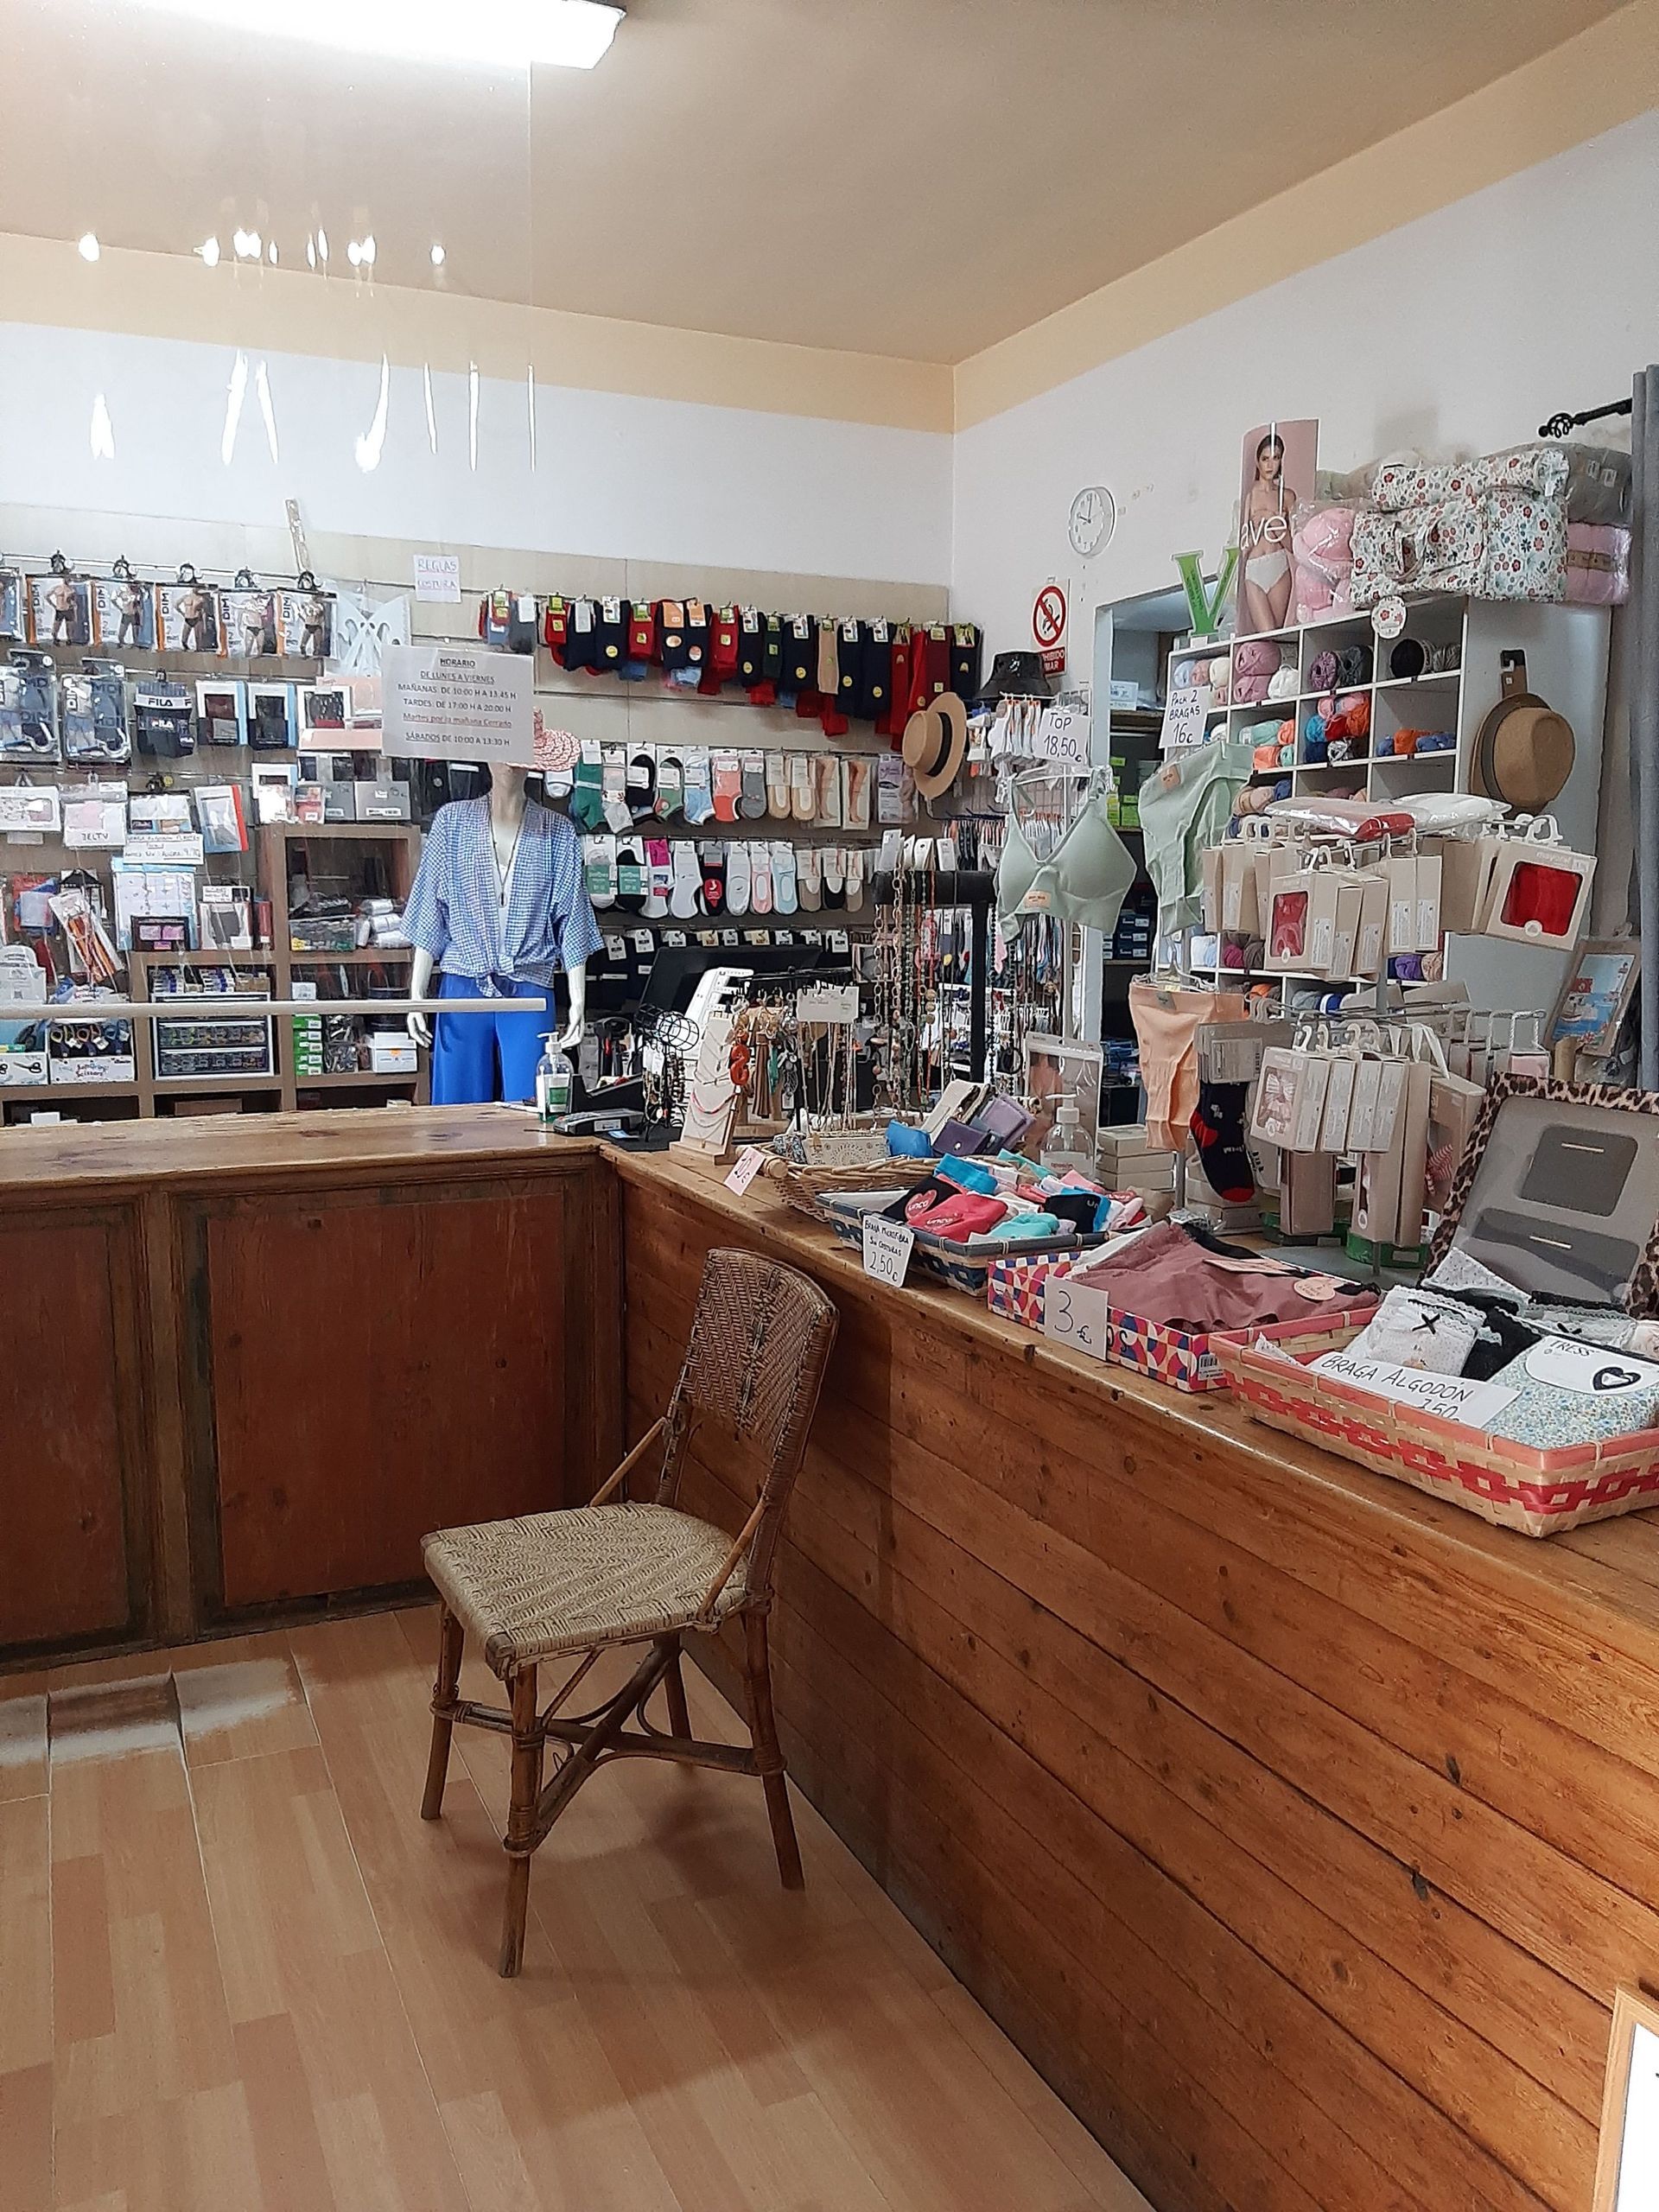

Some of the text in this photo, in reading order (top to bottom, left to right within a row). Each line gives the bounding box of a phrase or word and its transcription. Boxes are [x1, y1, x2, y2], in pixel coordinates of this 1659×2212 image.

[221, 597, 230, 620] DIM
[283, 596, 292, 619] DIM
[1042, 649, 1065, 662] HIBIDO
[440, 658, 475, 668] HORARIO
[1045, 661, 1058, 671] MAR
[420, 671, 430, 679] DE
[432, 672, 456, 681] LUNES
[463, 674, 495, 683] VIERNES
[148, 698, 173, 707] FILA
[1191, 690, 1198, 703] 2
[1169, 705, 1201, 721] BRAGAS
[483, 719, 512, 728] Cerrado
[1050, 712, 1071, 730] TOP
[406, 731, 441, 741] SÁBADOS
[1321, 1355, 1474, 1402] BRAGA ALGODÓN
